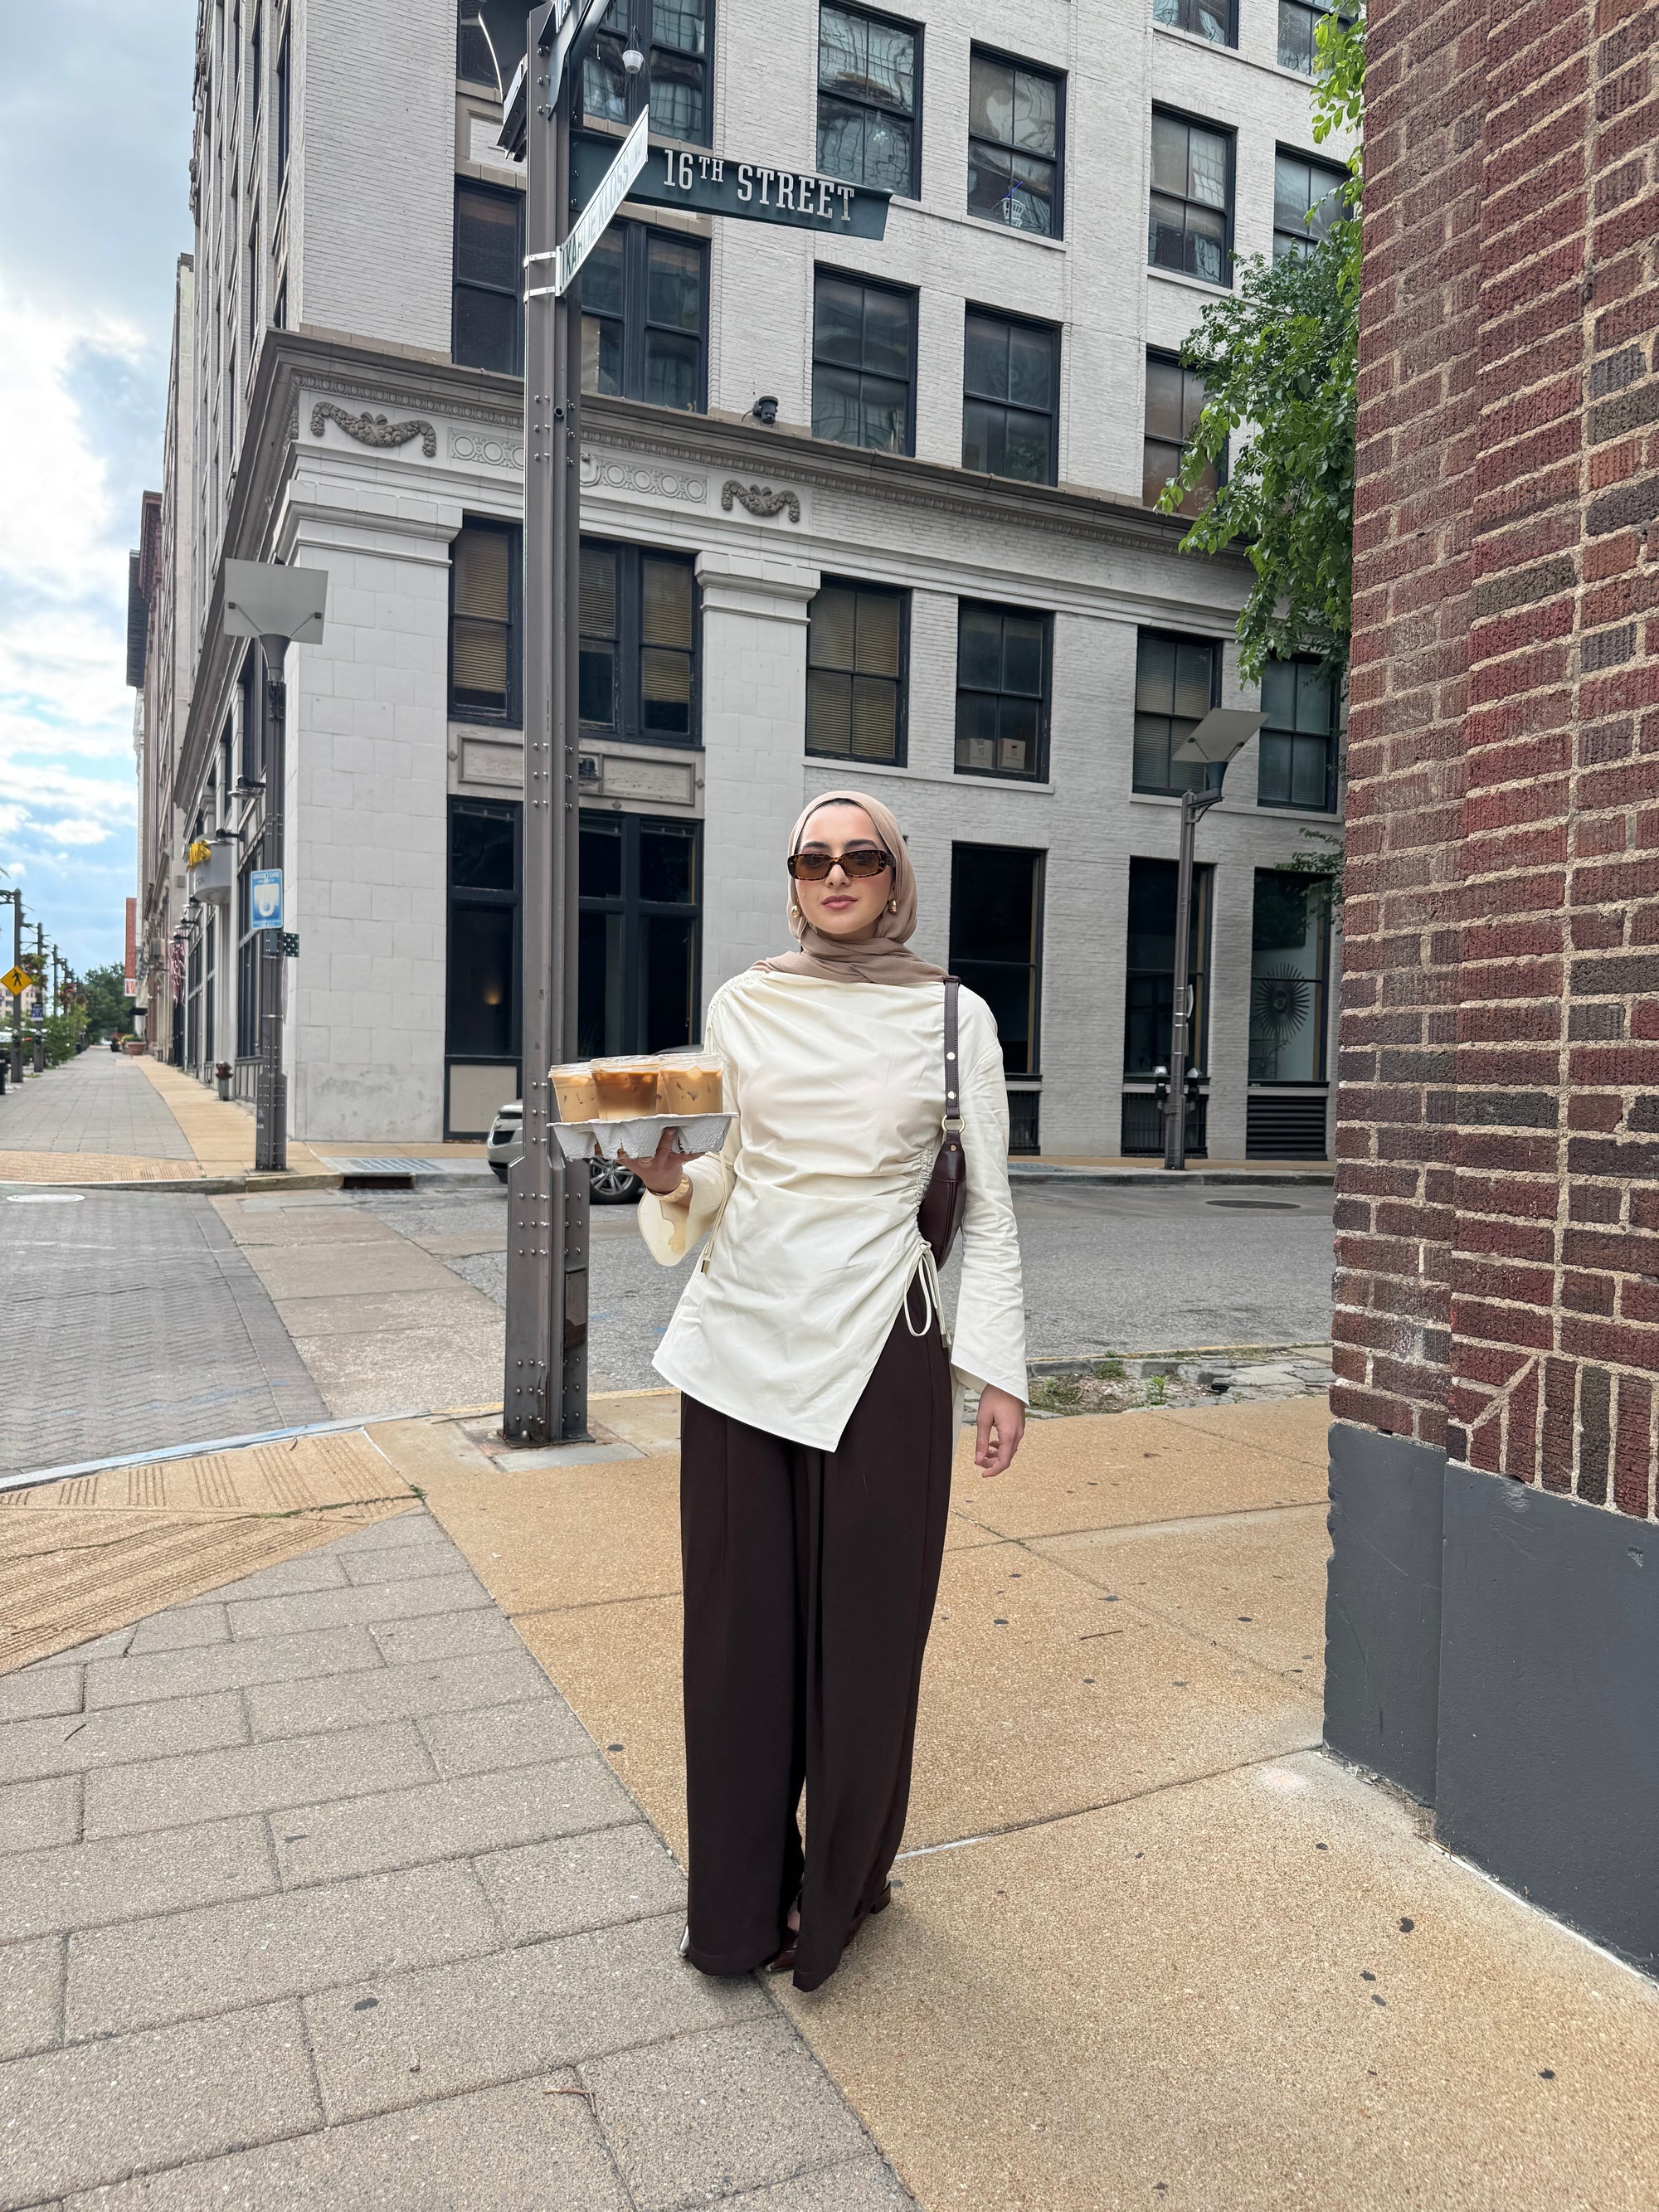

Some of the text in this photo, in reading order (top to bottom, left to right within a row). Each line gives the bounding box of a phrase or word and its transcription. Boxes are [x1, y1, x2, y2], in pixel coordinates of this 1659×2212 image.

[598, 149, 630, 227] KLOSS
[663, 148, 725, 191] 16TH
[737, 164, 855, 222] STREET
